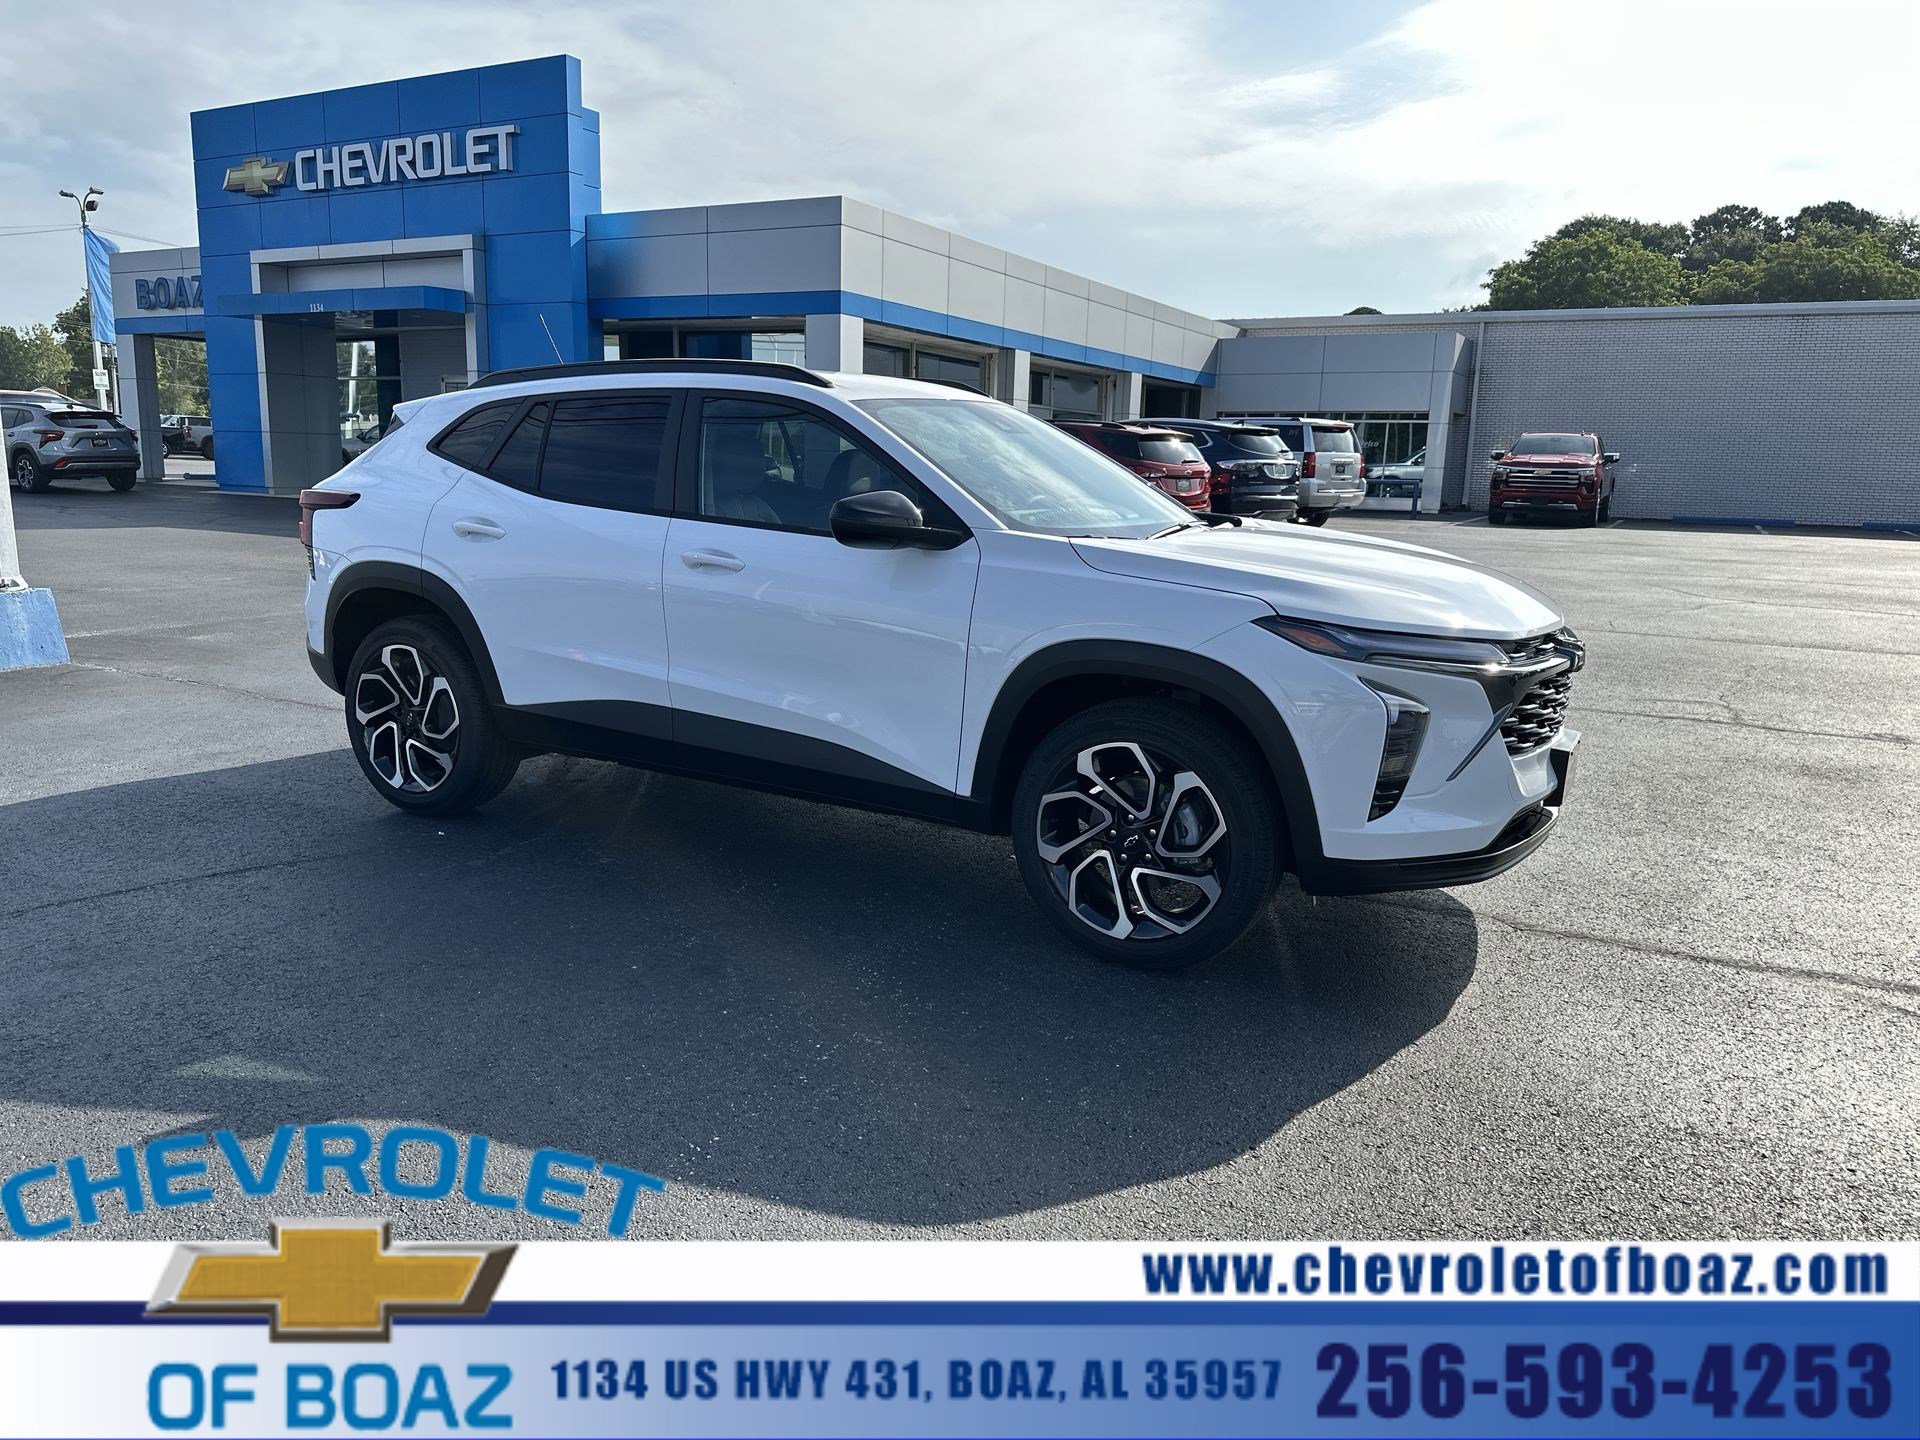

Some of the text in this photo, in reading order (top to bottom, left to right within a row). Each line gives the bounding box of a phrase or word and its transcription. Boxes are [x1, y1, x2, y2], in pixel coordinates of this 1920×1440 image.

[295, 124, 519, 191] CHEVROLET
[135, 275, 204, 310] BOAZ
[310, 303, 324, 312] 1134
